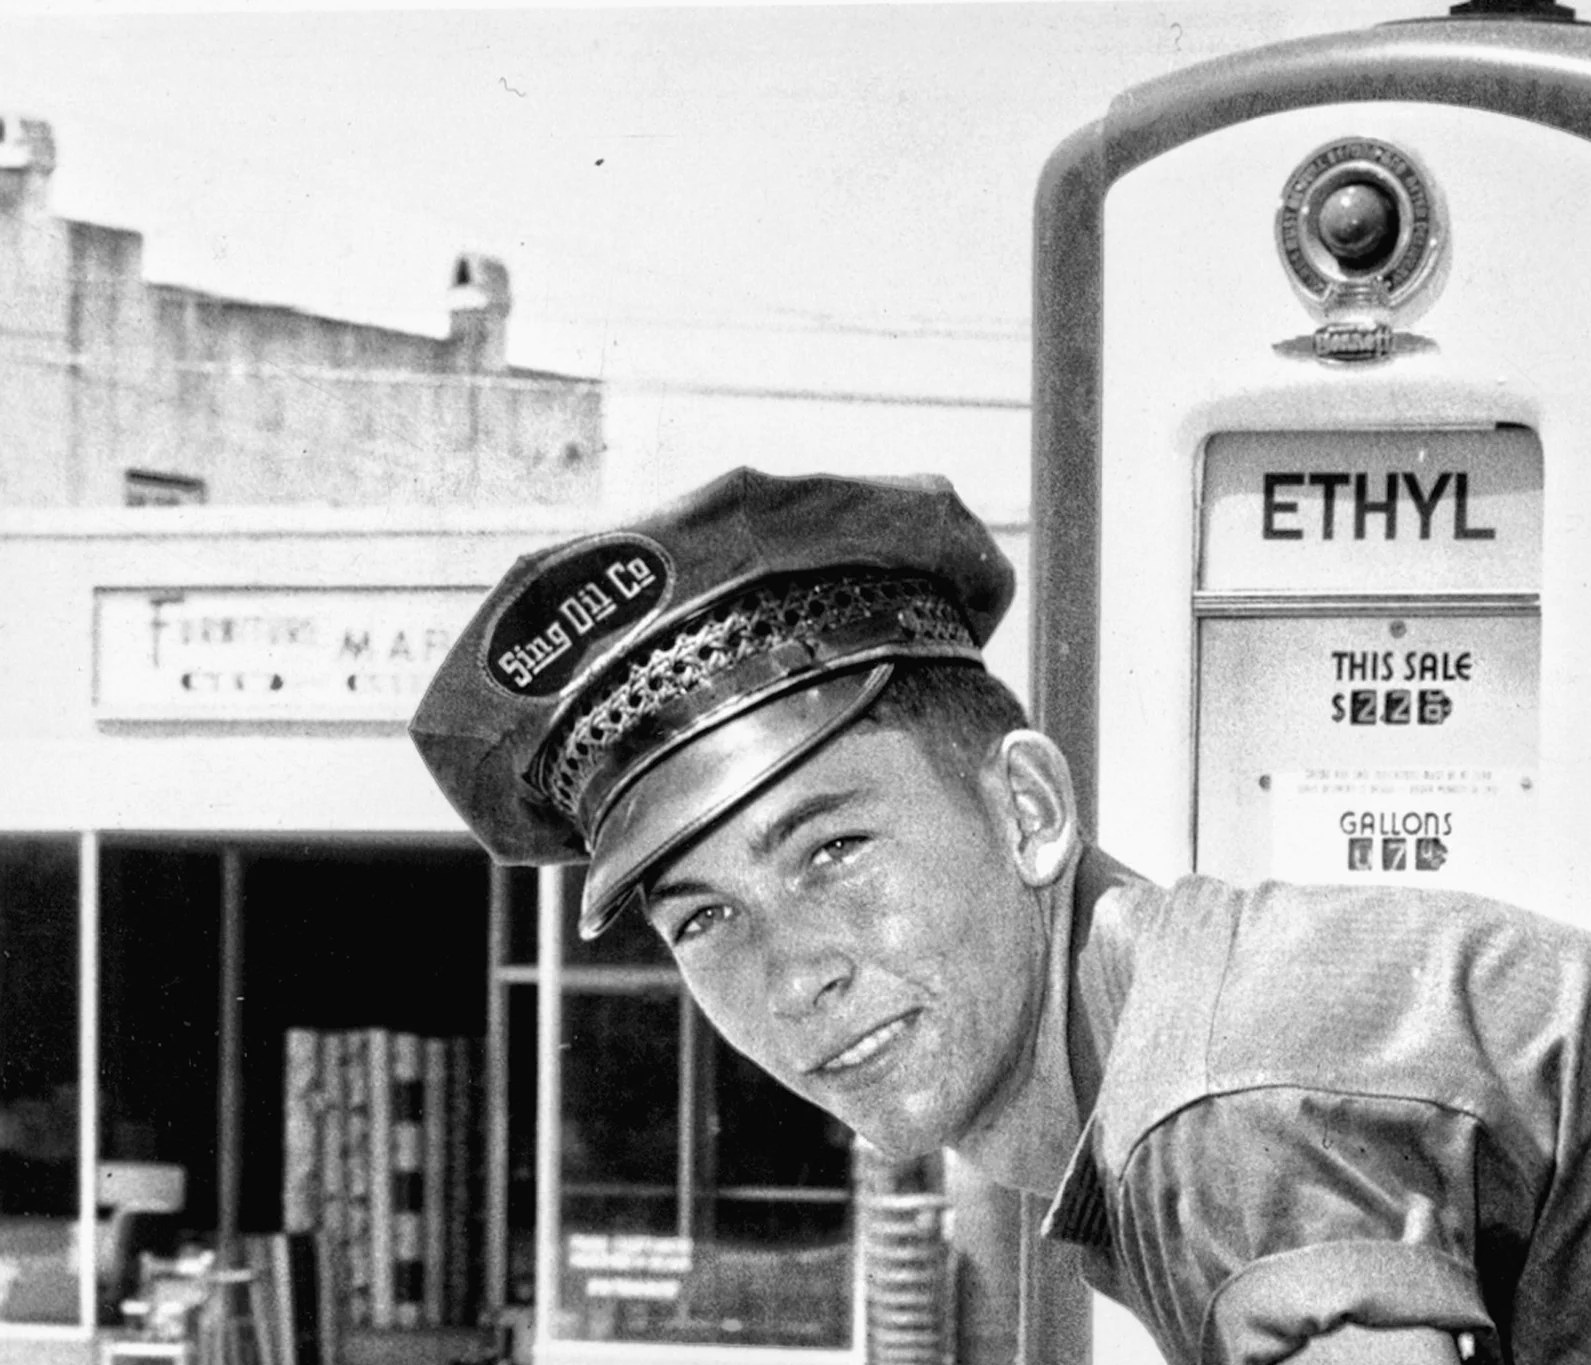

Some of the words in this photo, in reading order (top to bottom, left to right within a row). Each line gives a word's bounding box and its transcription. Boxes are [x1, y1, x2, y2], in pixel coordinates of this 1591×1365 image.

[1263, 472, 1496, 540] ETHYL
[498, 622, 572, 687] Sing
[559, 582, 617, 636] Oil
[606, 557, 656, 599] Co
[1331, 651, 1394, 681] THIS
[1404, 651, 1472, 681] SALE
[1340, 811, 1453, 836] GALLONS
